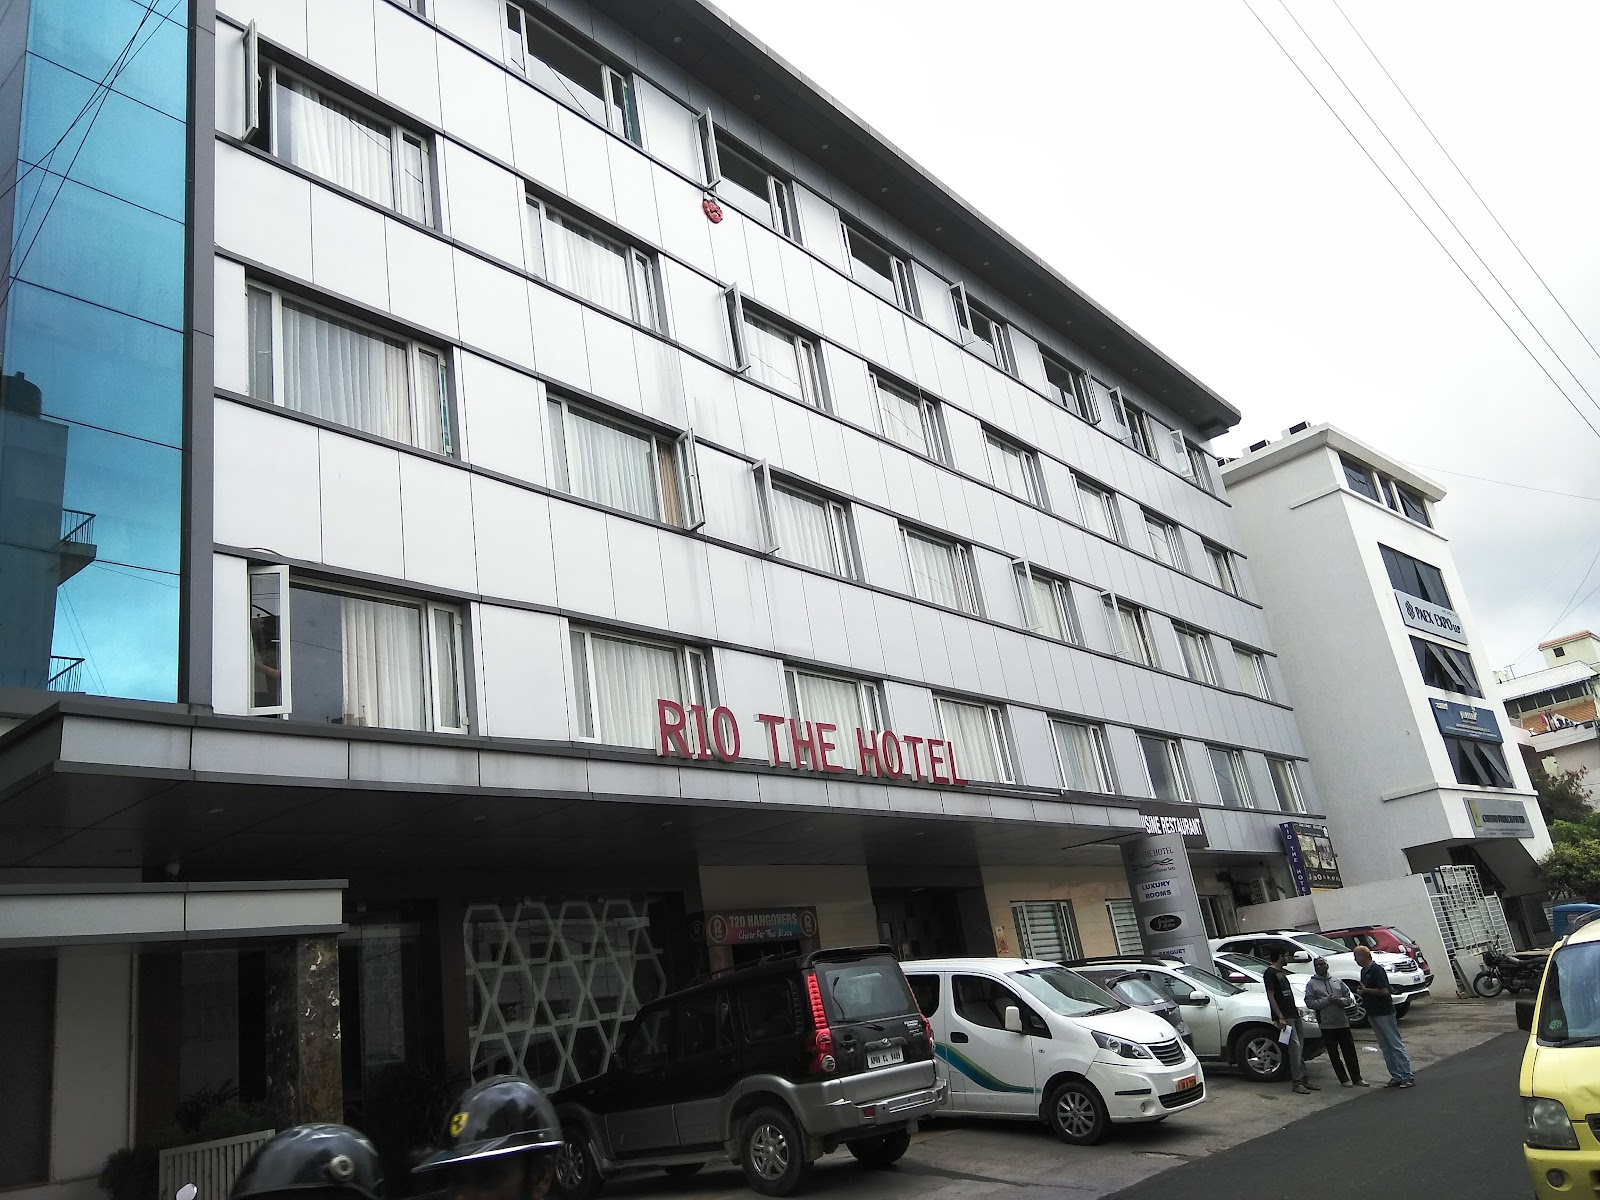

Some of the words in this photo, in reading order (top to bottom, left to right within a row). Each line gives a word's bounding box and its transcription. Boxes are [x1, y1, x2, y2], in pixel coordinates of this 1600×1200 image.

[1414, 606, 1435, 625] PAEX
[1433, 613, 1453, 631] EXPO
[657, 698, 741, 763] RIO
[753, 713, 845, 773] THE
[855, 727, 969, 786] HOTEL
[1160, 816, 1202, 835] RESTAURANT
[1284, 824, 1292, 839] RIO
[1290, 846, 1298, 862] THE
[1153, 846, 1174, 857] HOTEL
[1142, 880, 1170, 890] LUXURY
[1145, 890, 1172, 899] ROOMS
[729, 916, 746, 928] T20
[747, 913, 798, 927] HANGOVERS
[738, 930, 756, 940] Cheer
[755, 929, 765, 939] For
[765, 928, 776, 938] The
